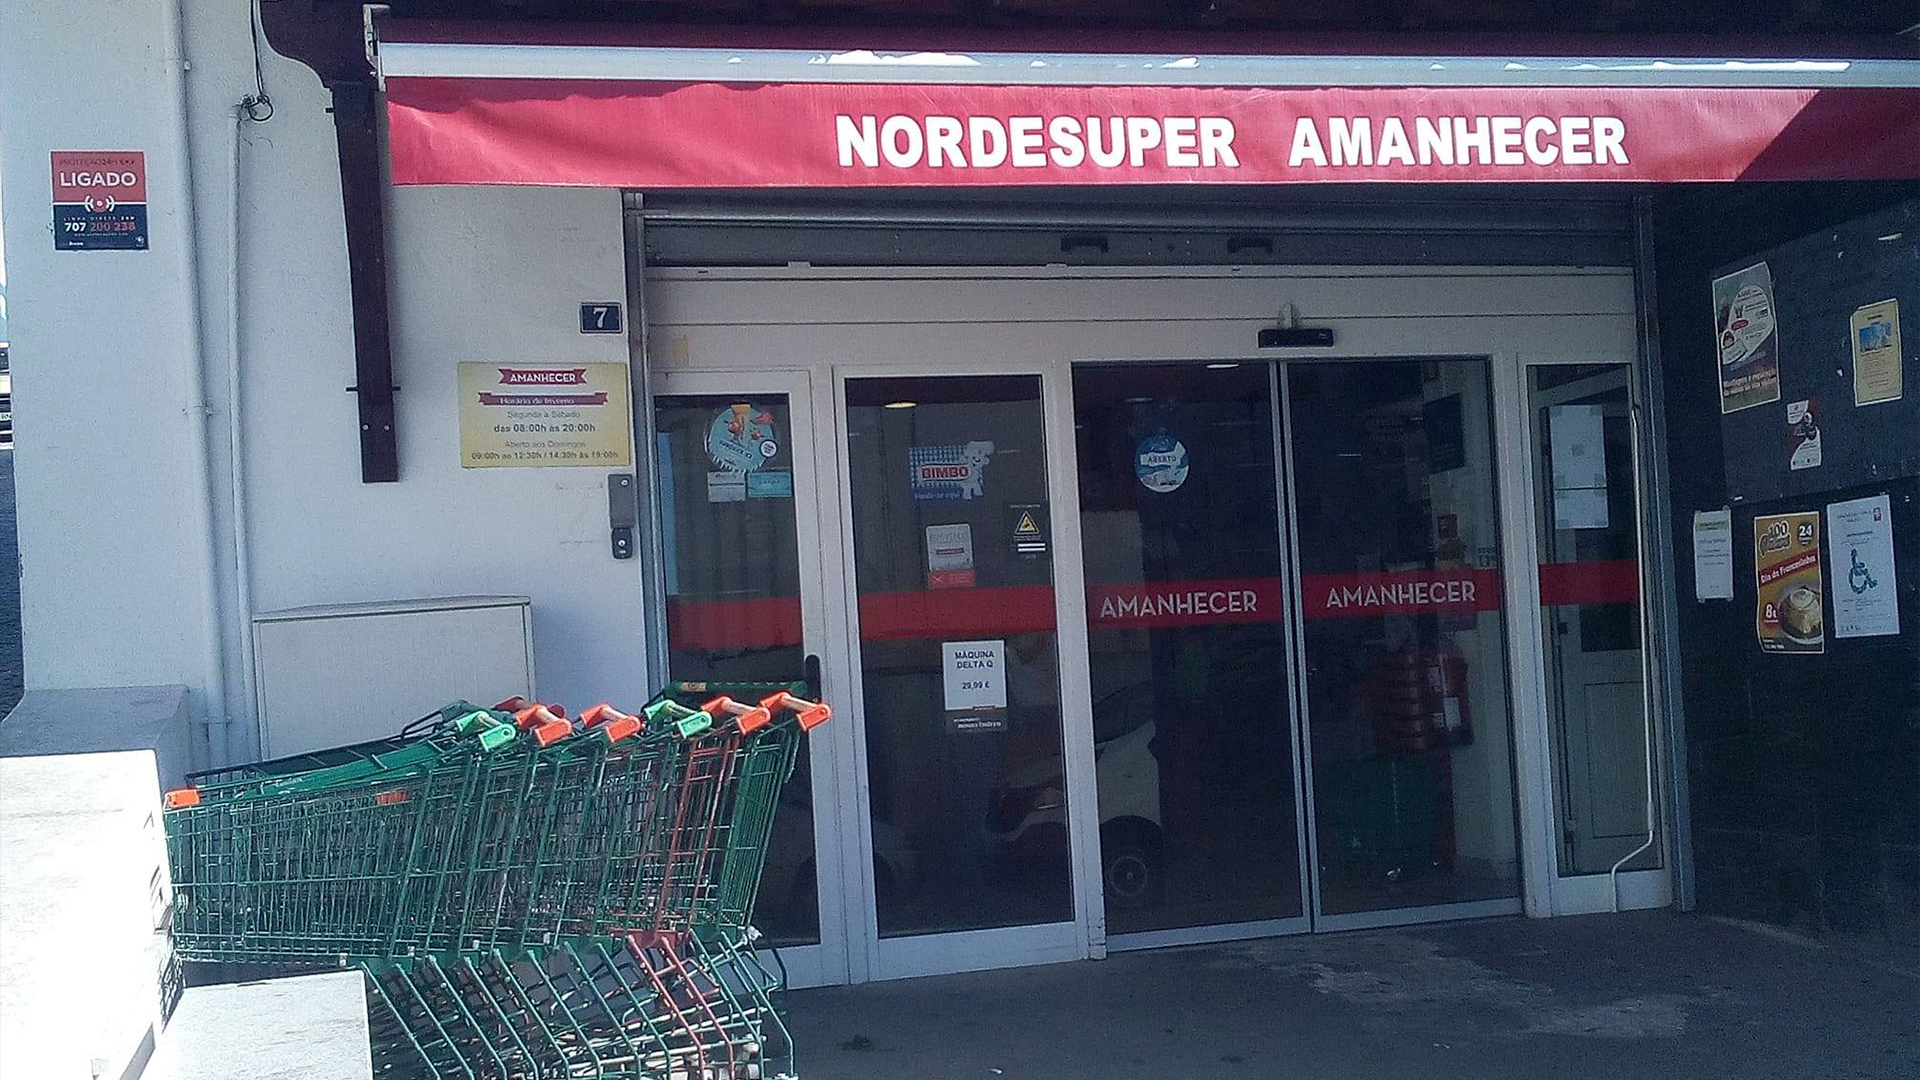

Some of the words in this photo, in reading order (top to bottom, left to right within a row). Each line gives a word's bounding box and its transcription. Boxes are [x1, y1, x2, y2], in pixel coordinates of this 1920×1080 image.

[834, 115, 1239, 168] NORDESUPER
[1288, 115, 1629, 167] AMANHECER
[59, 172, 137, 187] LIGADO
[64, 222, 87, 232] 707
[90, 222, 111, 232] 200
[593, 307, 608, 329] 7
[509, 373, 577, 383] AMANHECER
[493, 424, 511, 433] das
[562, 423, 596, 432] 20:00h
[921, 466, 969, 478] BIMBO
[1799, 525, 1813, 537] 24
[1761, 574, 1771, 583] Dia
[1326, 580, 1476, 608] AMANHECER
[1100, 590, 1257, 618] AMANHECER
[957, 660, 985, 669] DELTA
[986, 659, 994, 668] Q
